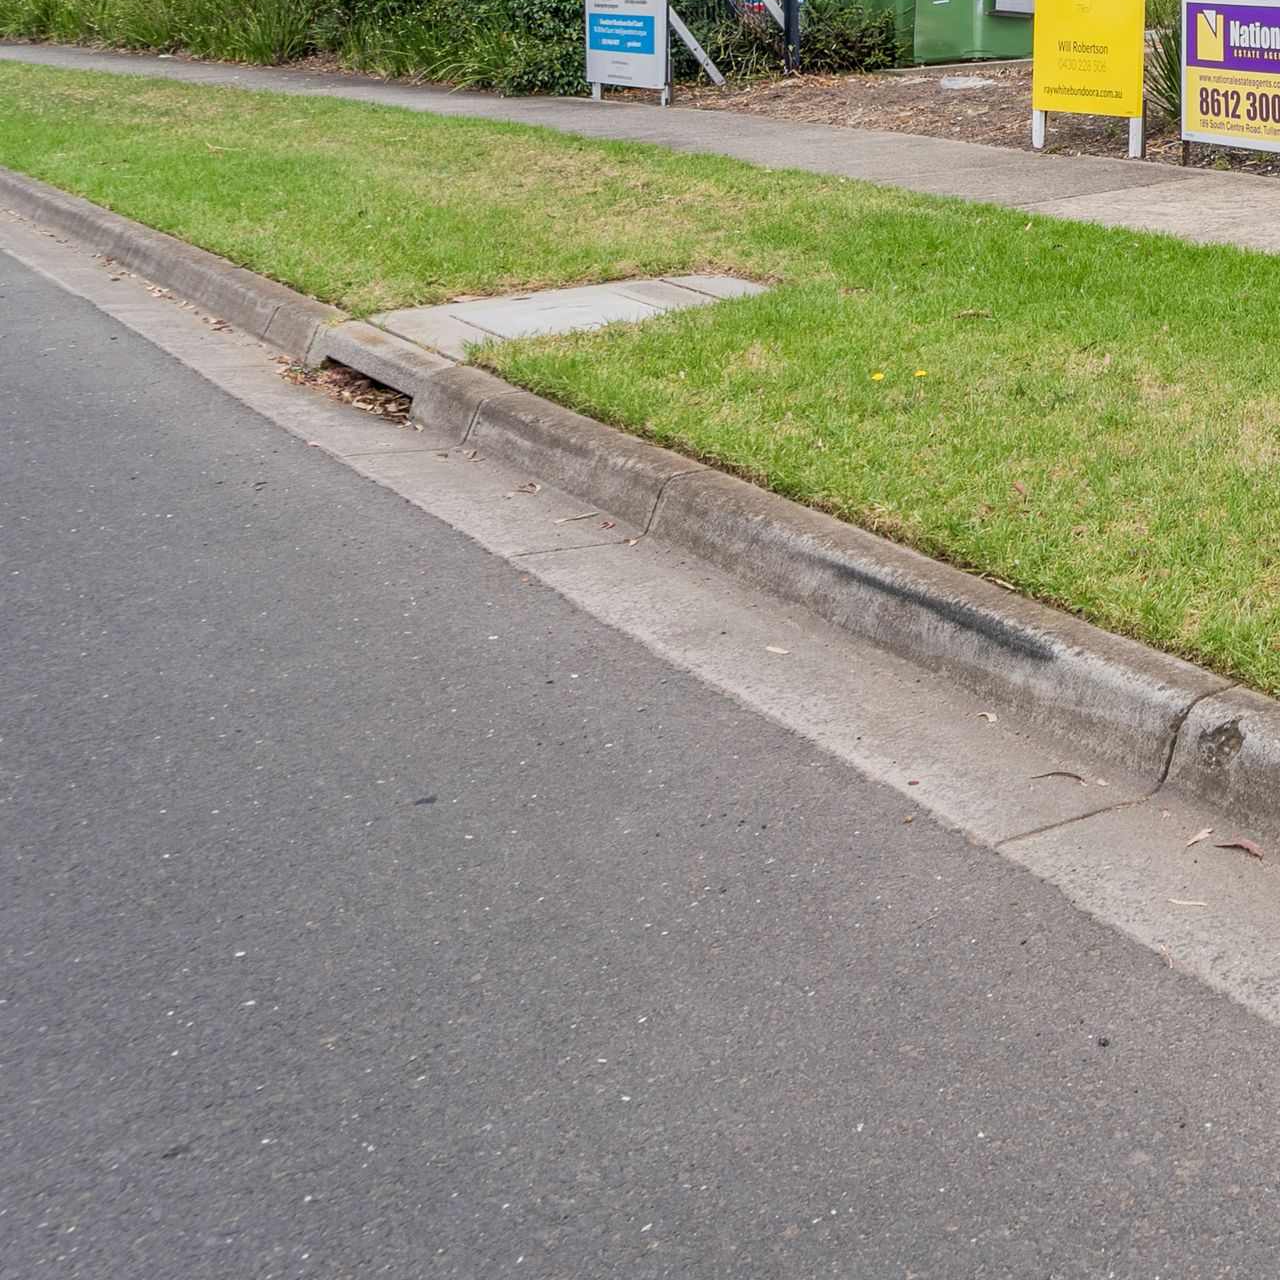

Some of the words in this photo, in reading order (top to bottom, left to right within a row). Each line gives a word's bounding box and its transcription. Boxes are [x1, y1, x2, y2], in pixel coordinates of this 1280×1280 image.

[1058, 40, 1072, 52] Will
[1073, 40, 1109, 56] Robertson
[1233, 49, 1260, 59] ESTATE
[1058, 58, 1077, 70] 0430
[1044, 85, 1122, 99] raywhitebundoora.com.au
[1199, 87, 1241, 119] 8612
[1209, 119, 1226, 130] South
[1226, 121, 1245, 132] Centre
[1246, 124, 1263, 135] Road,
